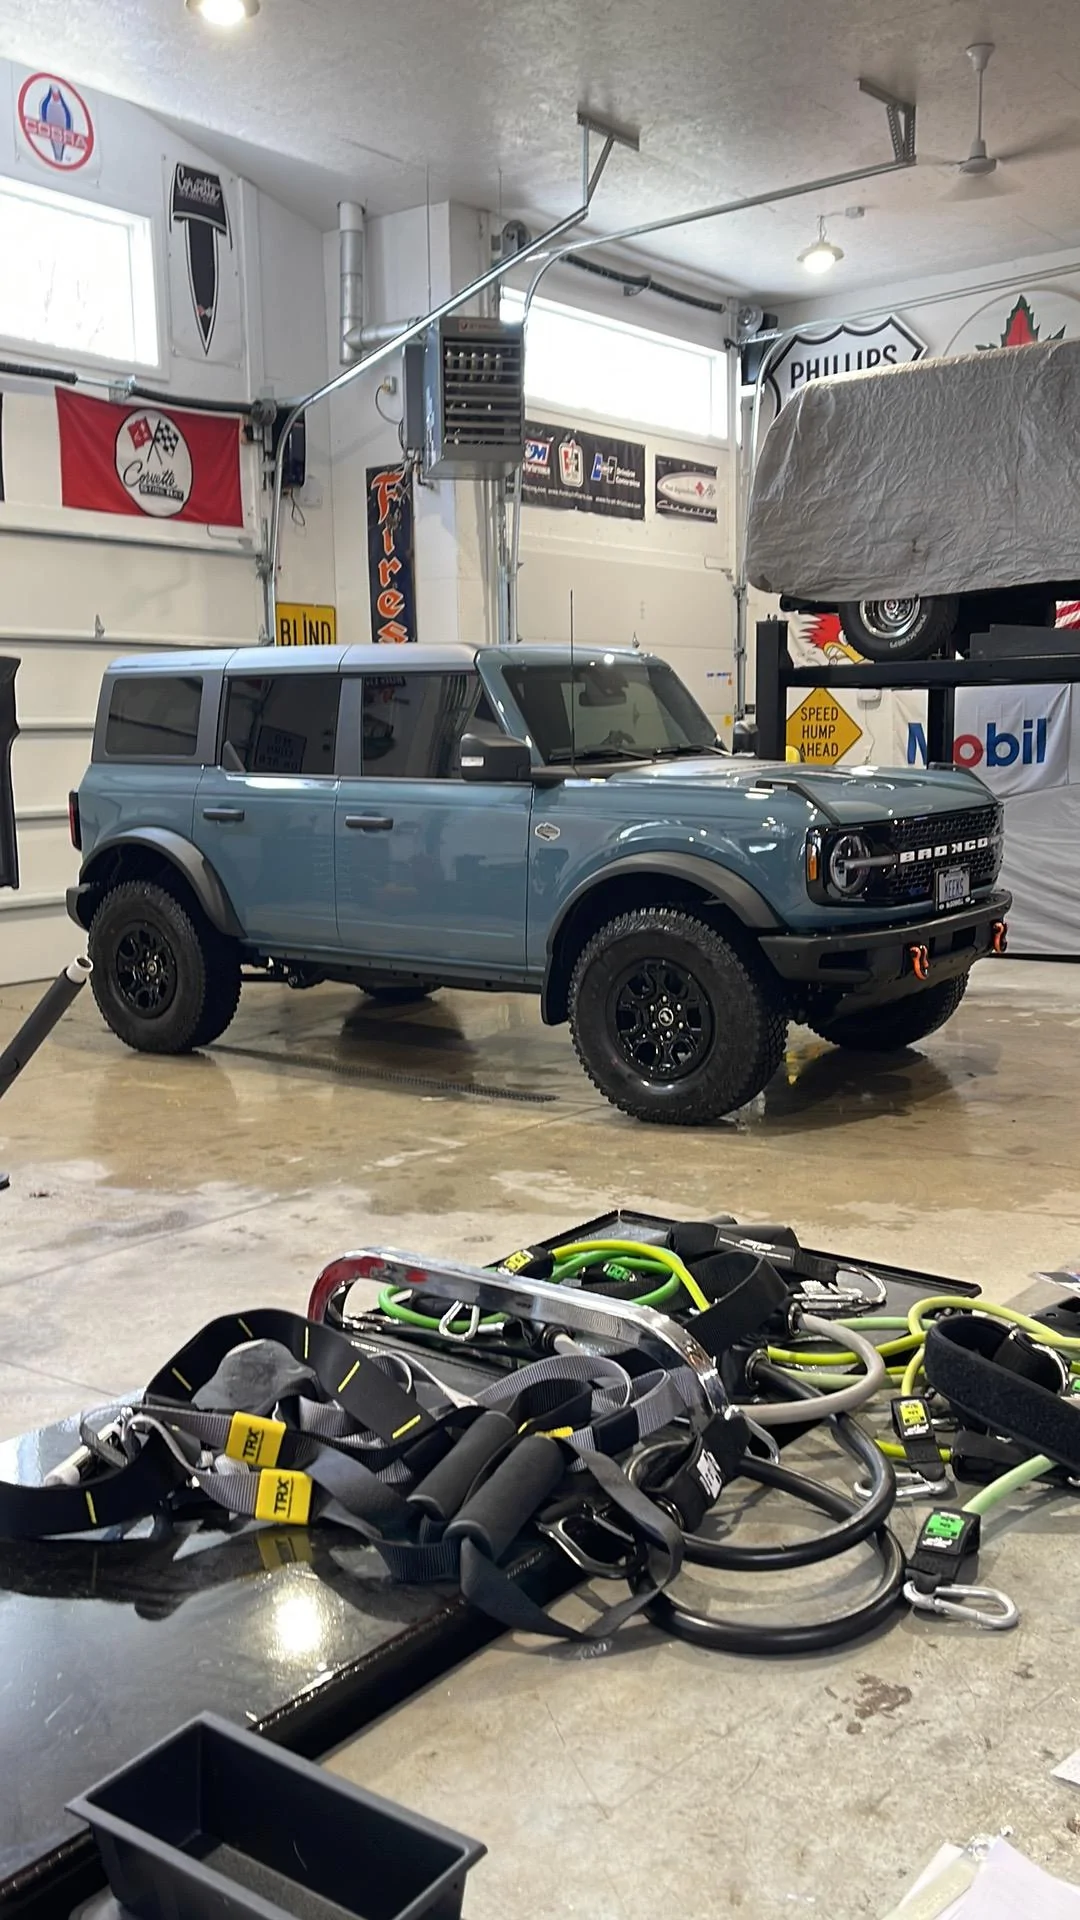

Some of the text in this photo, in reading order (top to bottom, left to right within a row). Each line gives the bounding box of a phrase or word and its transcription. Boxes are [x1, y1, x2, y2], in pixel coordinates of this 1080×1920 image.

[123, 459, 178, 488] Corvette
[280, 618, 331, 645] BLIND
[801, 707, 838, 721] SPEED
[802, 725, 835, 739] HUMP
[800, 742, 838, 757] AHEAD
[900, 837, 988, 863] BRONCO
[242, 1427, 260, 1459] TRX
[274, 1476, 290, 1515] TRX
